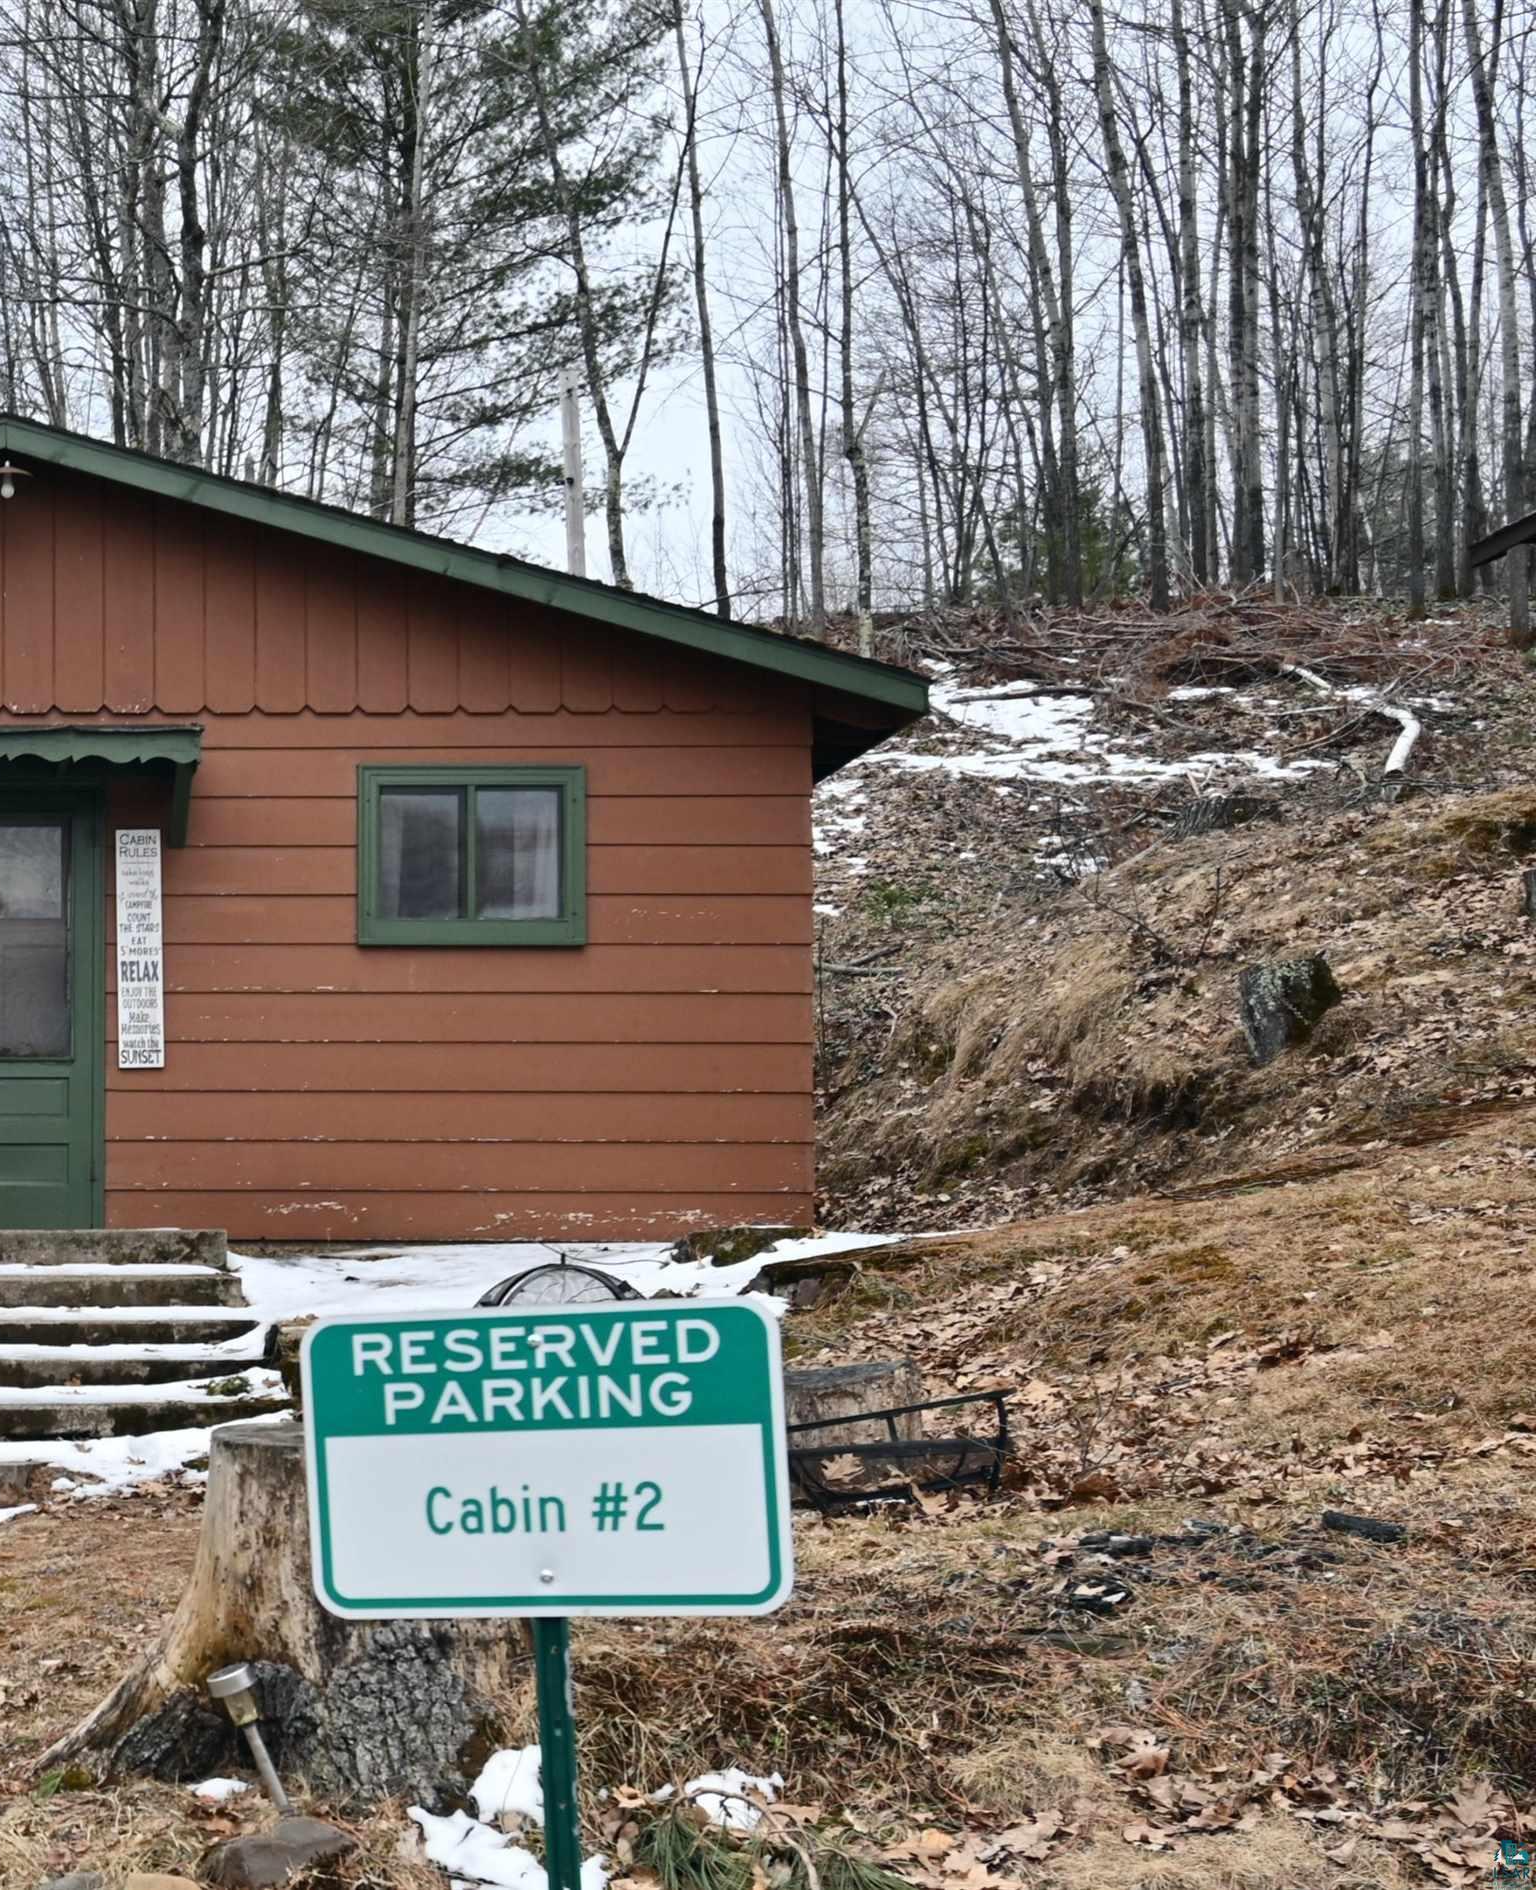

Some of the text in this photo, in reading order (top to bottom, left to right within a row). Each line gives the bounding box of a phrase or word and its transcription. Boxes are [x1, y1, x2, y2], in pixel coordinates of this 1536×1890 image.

[119, 833, 157, 845] CABIN
[119, 846, 158, 857] RULES
[127, 912, 151, 922] COUNT
[119, 922, 160, 932] THE STARS
[131, 936, 146, 945] EAT
[120, 960, 159, 982] RELAX
[120, 1049, 162, 1065] SUNSET
[350, 1318, 721, 1377] RESERVED
[383, 1371, 694, 1426] PARKING
[425, 1480, 665, 1535] Cabin #2
